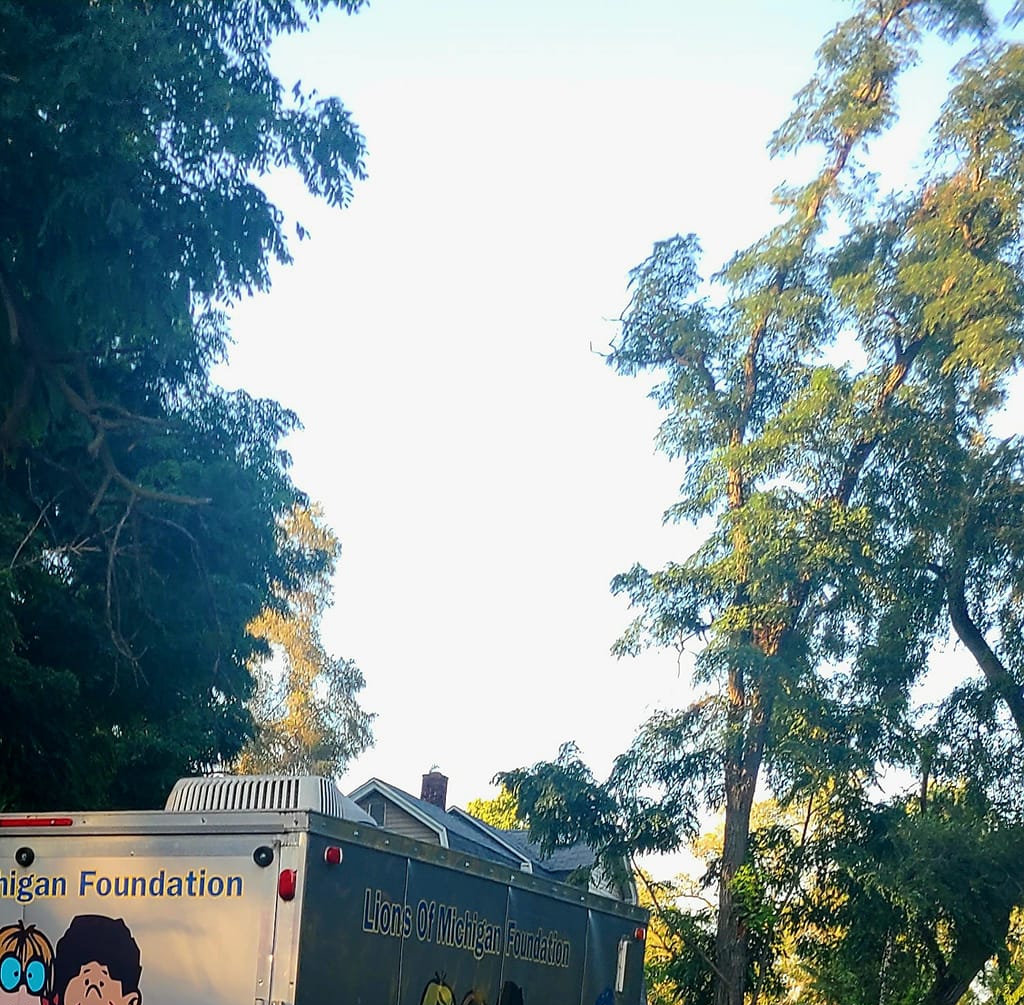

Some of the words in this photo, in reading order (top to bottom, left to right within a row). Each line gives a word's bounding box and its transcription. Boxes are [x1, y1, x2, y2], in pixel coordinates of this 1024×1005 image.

[78, 869, 244, 898] Foundation
[362, 888, 413, 938] Lions
[416, 899, 436, 942] Of
[437, 905, 501, 960] Michigan
[505, 920, 570, 968] Foundation
